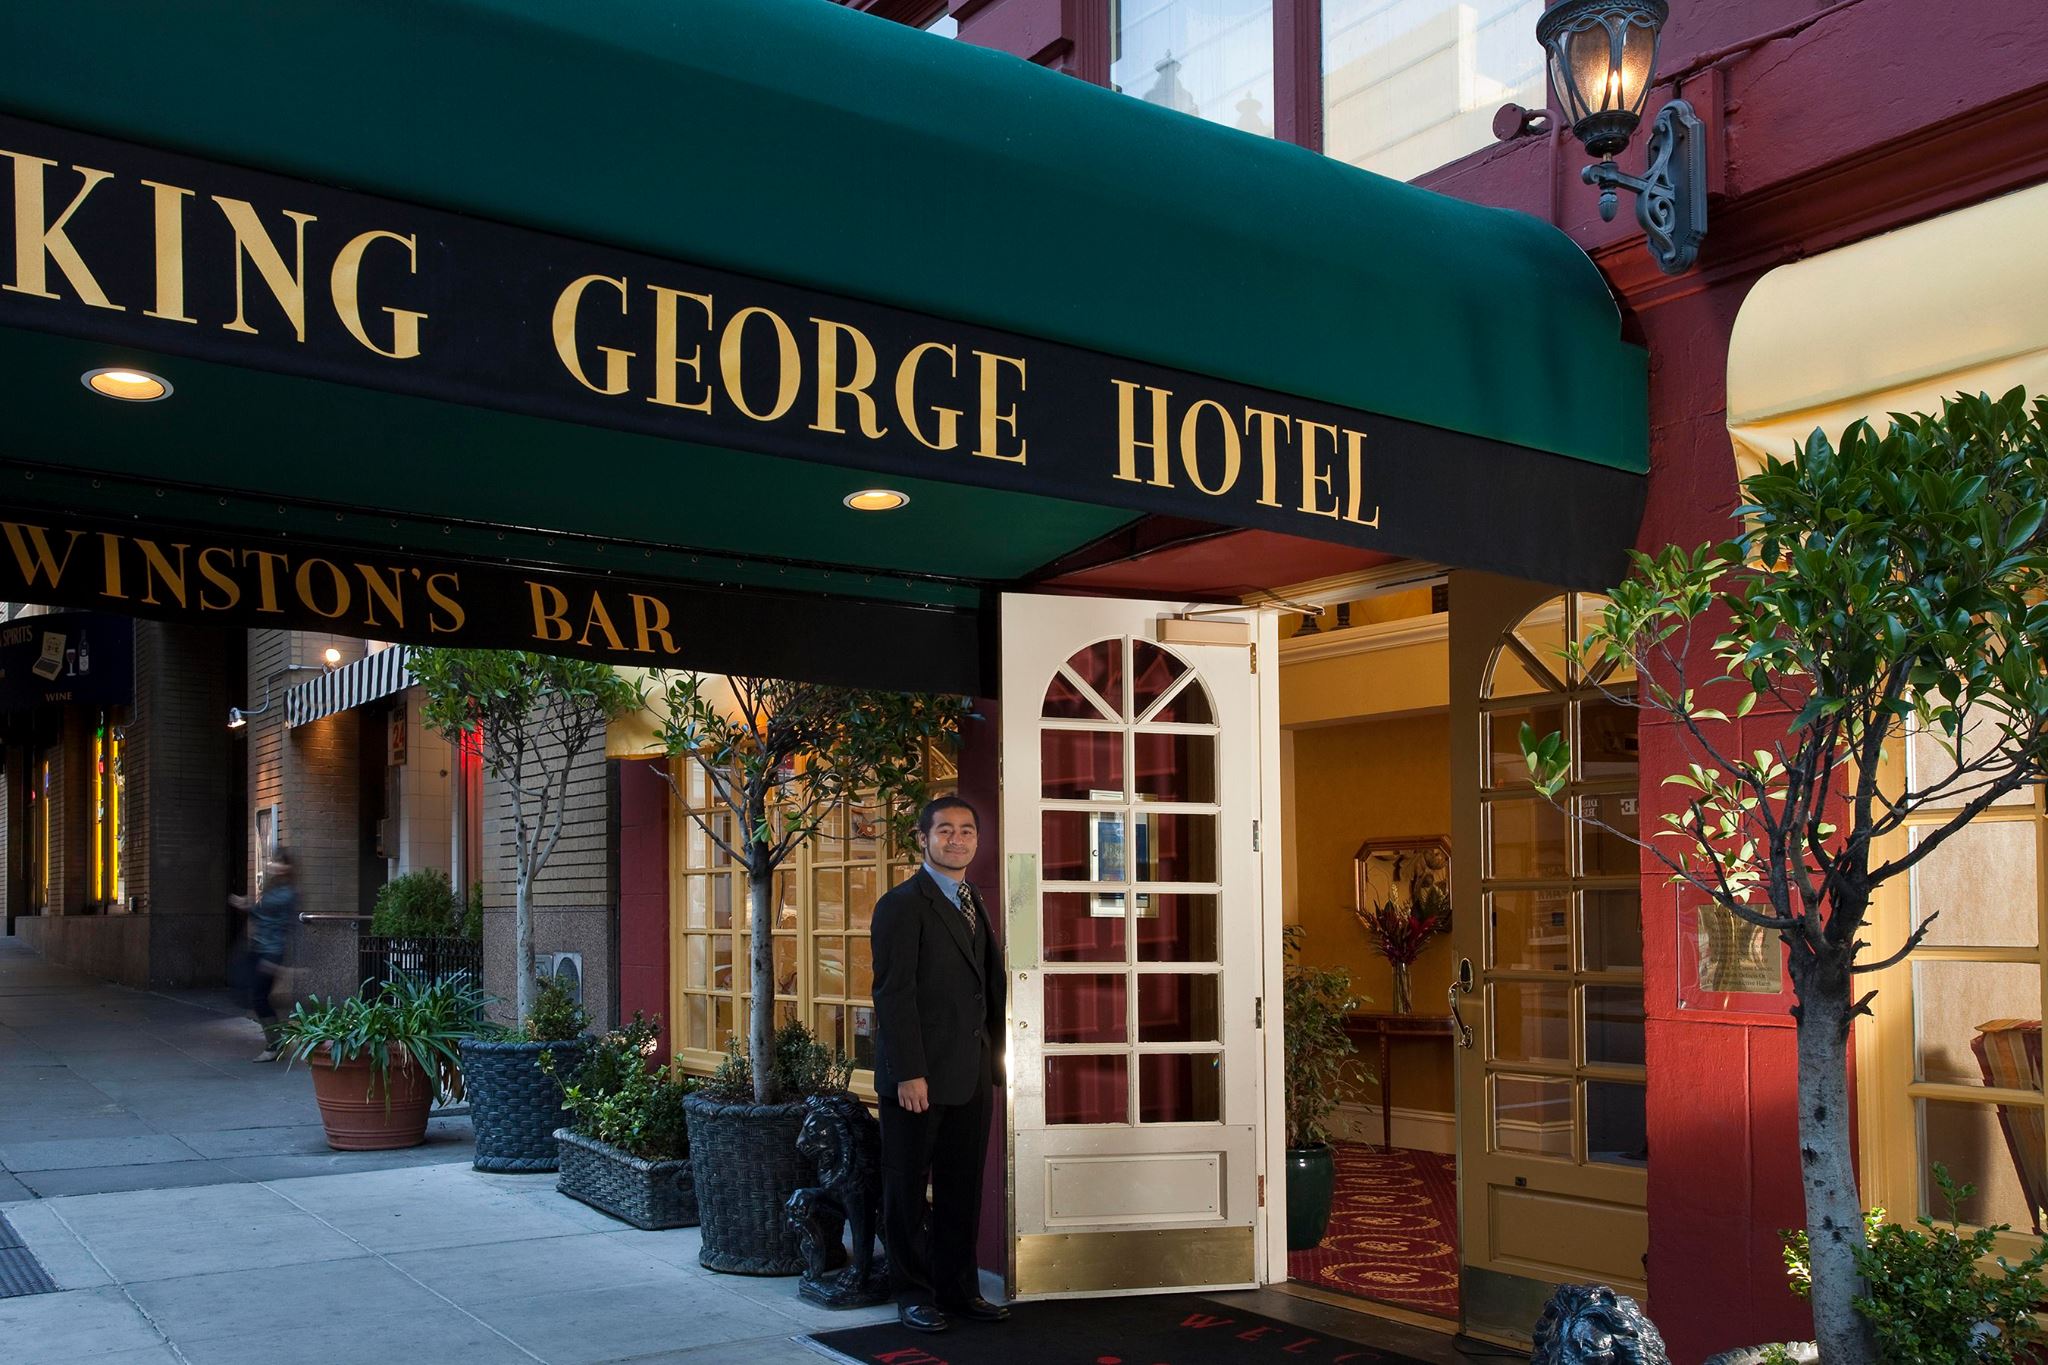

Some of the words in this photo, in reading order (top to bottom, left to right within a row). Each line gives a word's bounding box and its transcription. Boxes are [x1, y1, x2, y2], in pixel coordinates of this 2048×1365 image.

[0, 150, 428, 359] KING
[551, 274, 1028, 466] GEORGE
[1111, 379, 1380, 530] HOTEL
[0, 521, 466, 633] WINSTON'S
[524, 580, 682, 655] BAR
[45, 691, 73, 702] WINE
